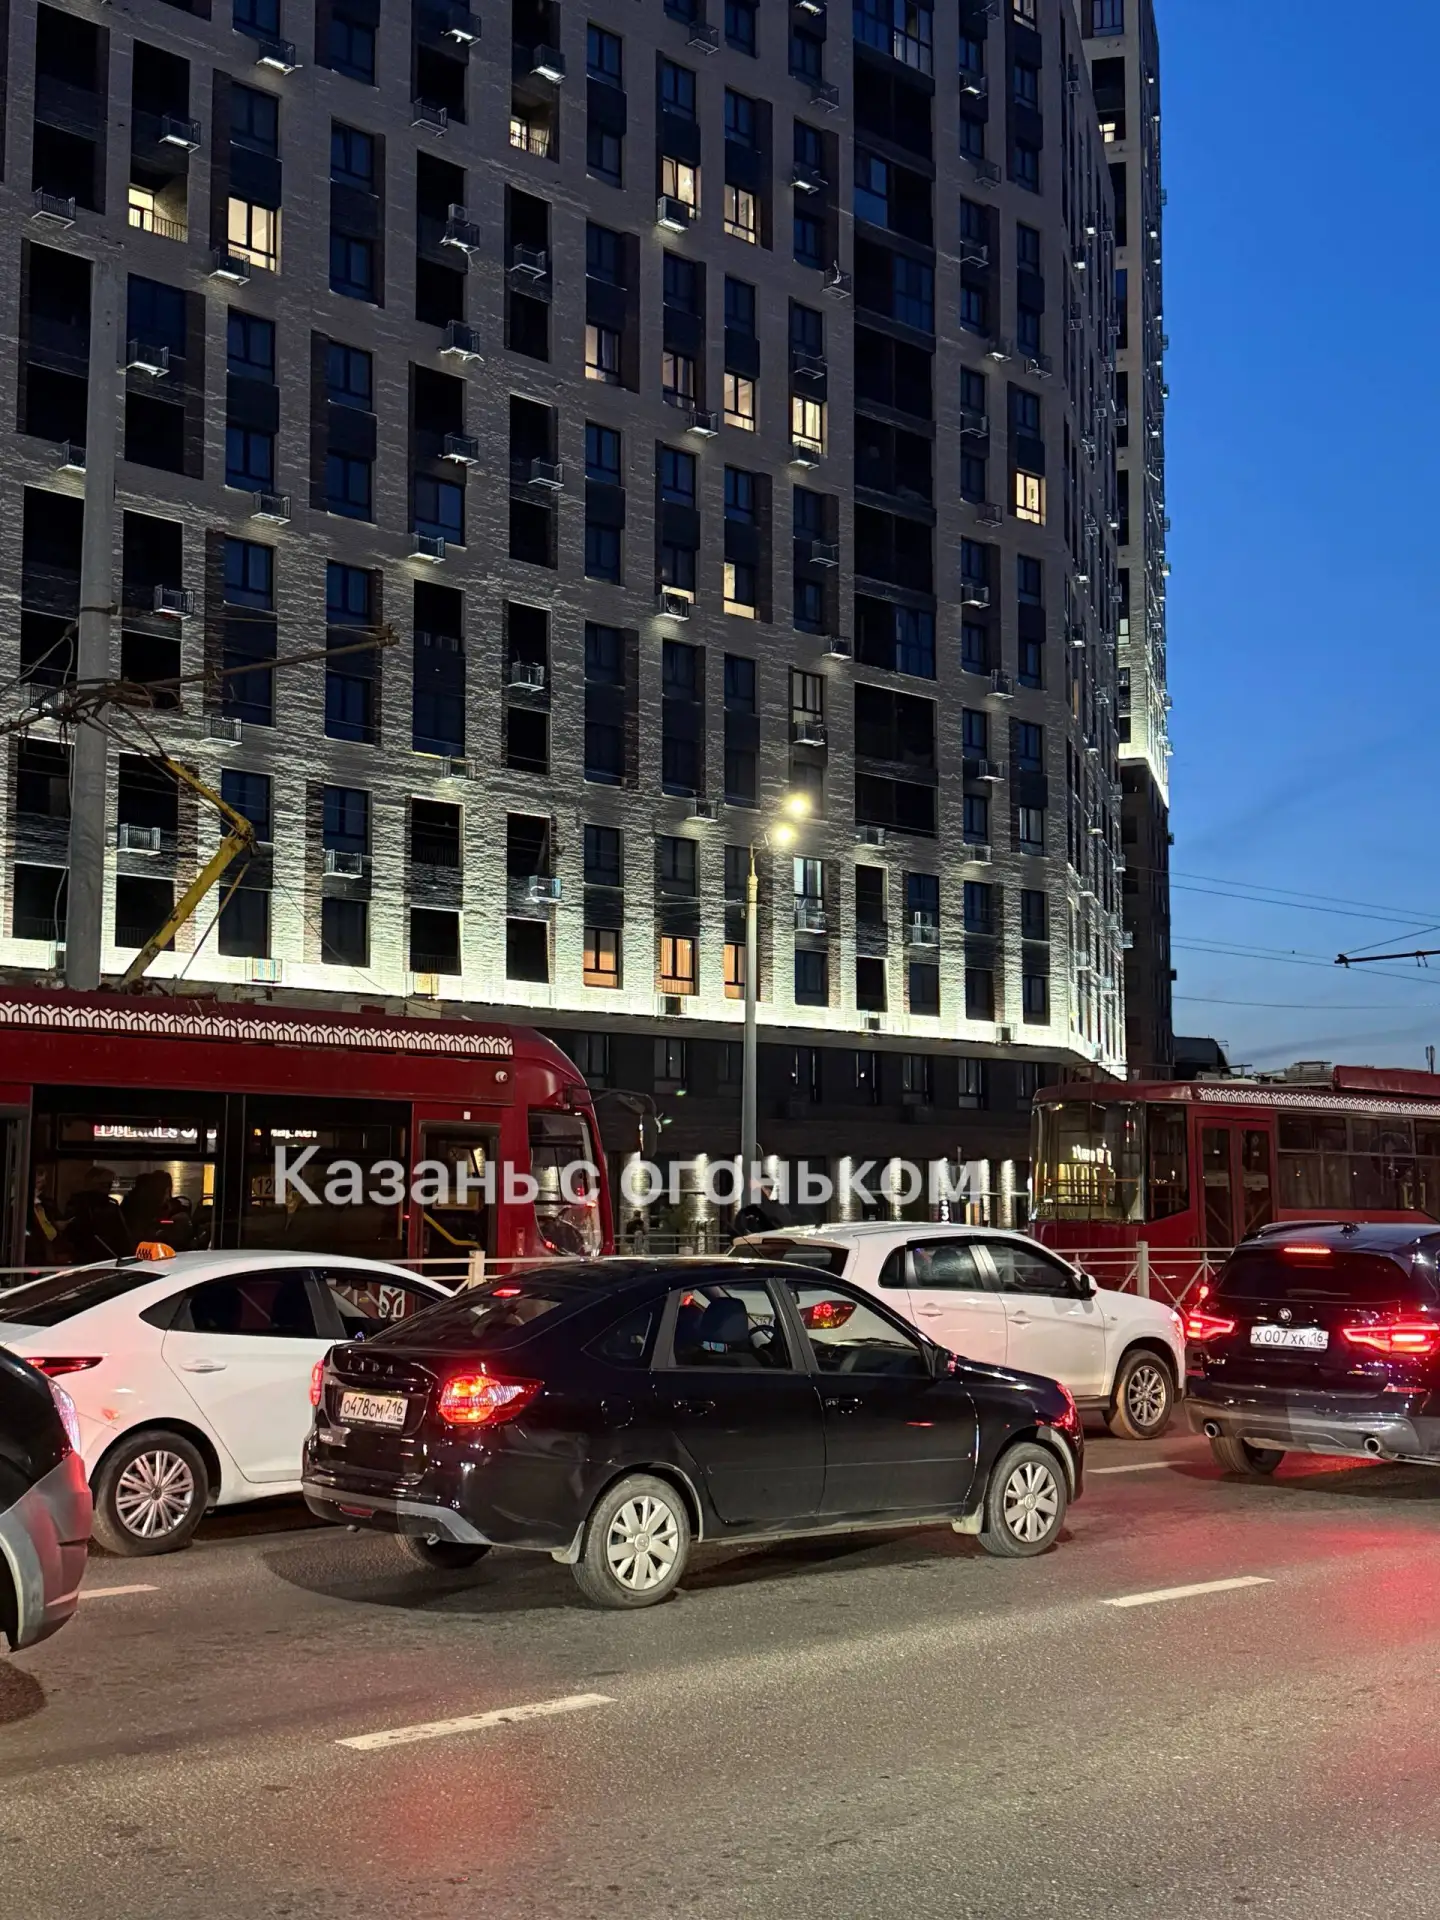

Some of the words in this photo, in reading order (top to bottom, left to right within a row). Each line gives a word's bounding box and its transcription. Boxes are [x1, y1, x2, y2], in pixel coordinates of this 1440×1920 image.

[1311, 1331, 1324, 1343] 16
[347, 1360, 393, 1374] LADA
[386, 1400, 403, 1415] 716
